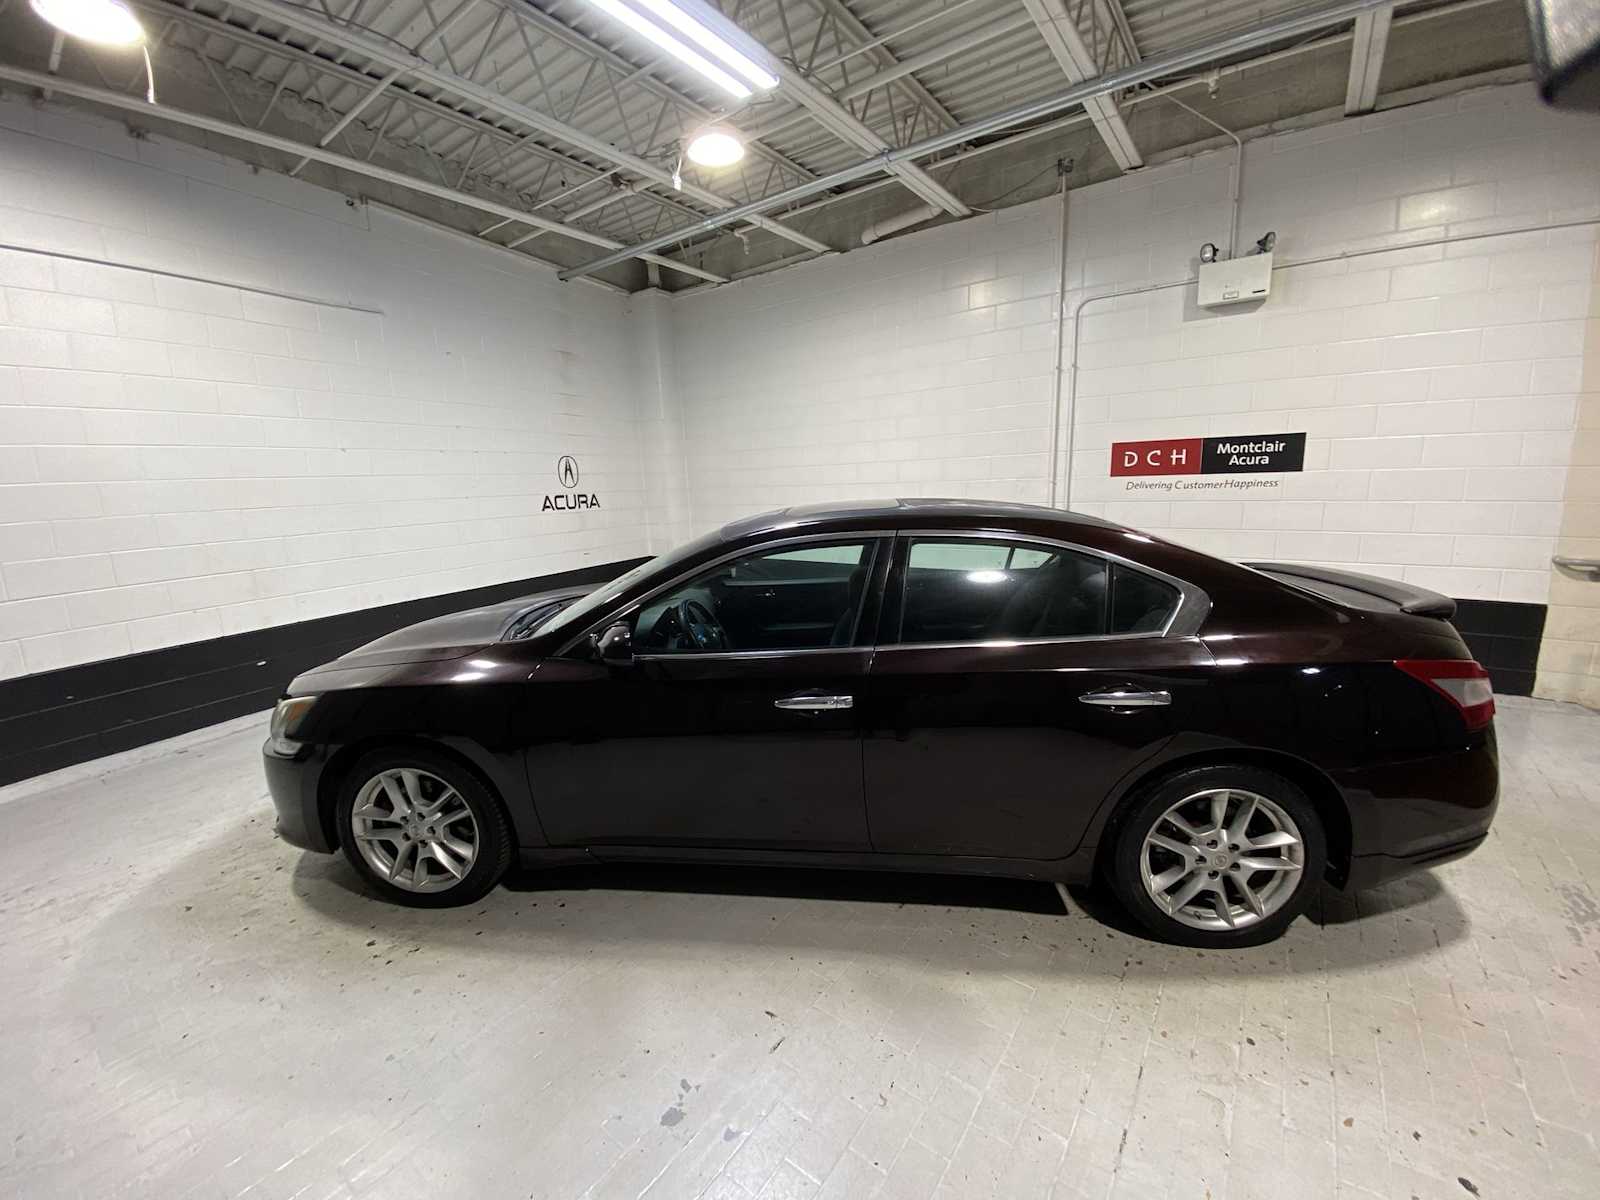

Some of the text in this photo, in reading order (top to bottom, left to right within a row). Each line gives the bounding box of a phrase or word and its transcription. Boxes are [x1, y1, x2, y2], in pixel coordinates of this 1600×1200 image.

[1216, 440, 1286, 455] Montclair
[1228, 454, 1270, 466] Acura
[1125, 480, 1172, 492] Delivering
[541, 493, 601, 512] ACURA
